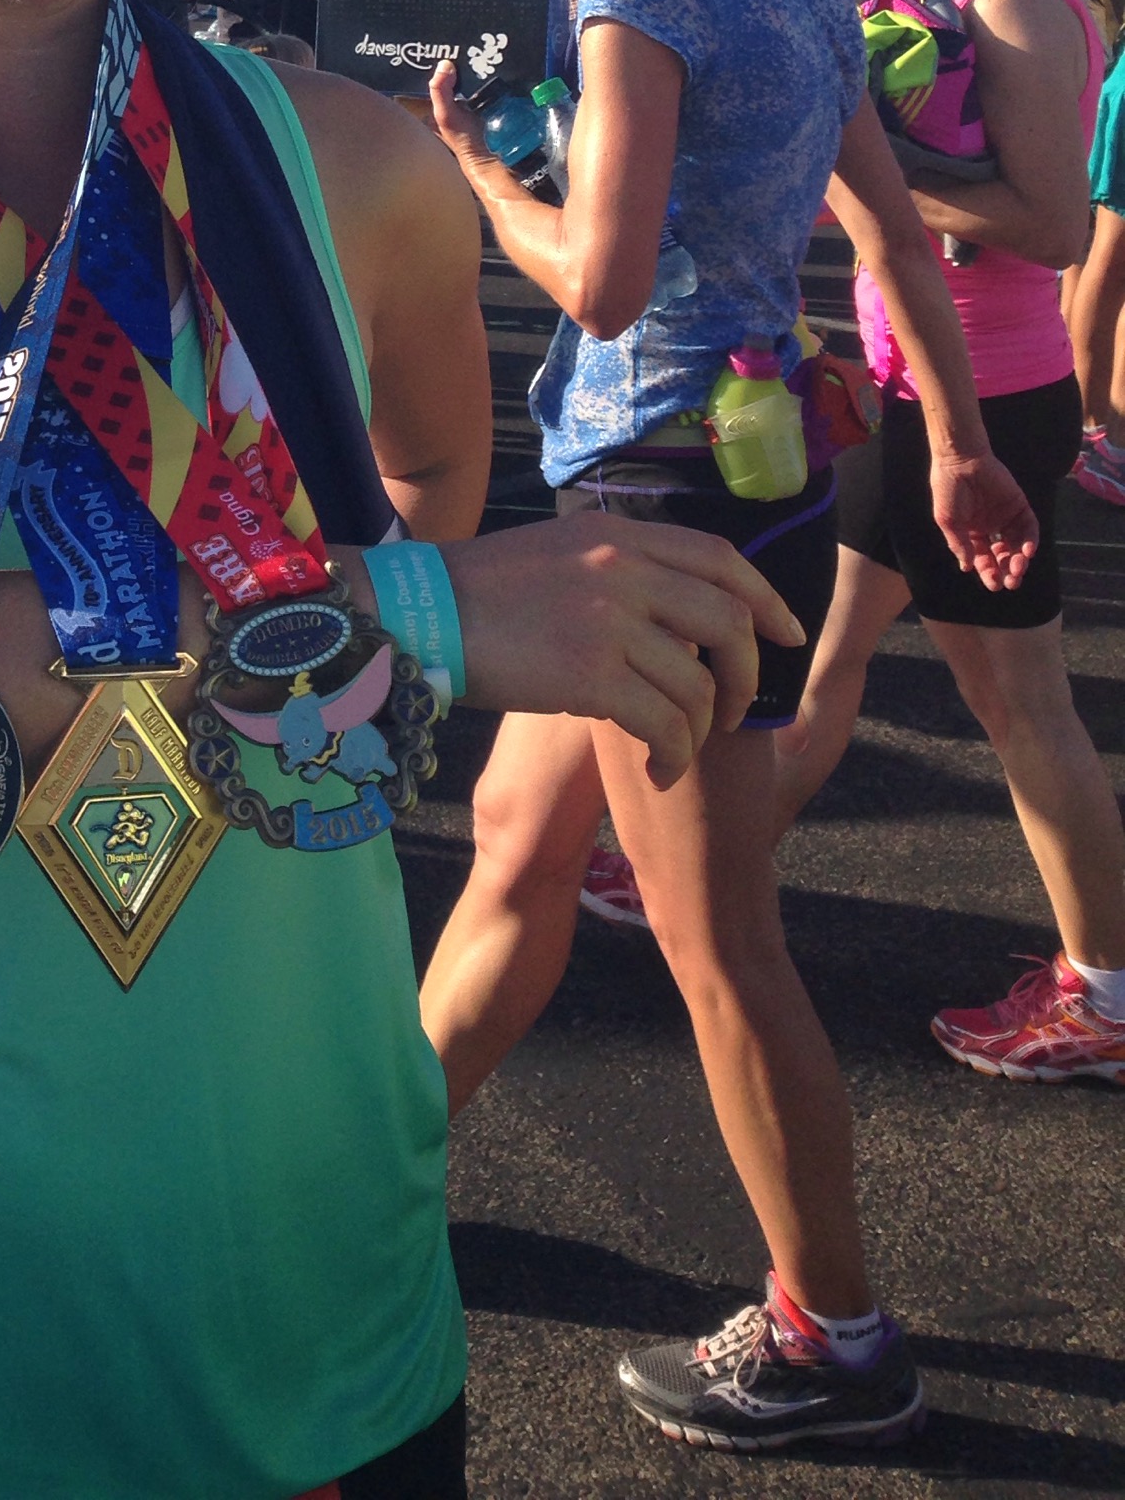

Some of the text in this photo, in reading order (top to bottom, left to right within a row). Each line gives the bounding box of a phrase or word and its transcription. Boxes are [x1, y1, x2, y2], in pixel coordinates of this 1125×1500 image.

[355, 33, 460, 70] runDisney
[219, 490, 260, 536] Cigna
[79, 490, 162, 650] MARATHON
[393, 570, 411, 605] Coast
[253, 613, 322, 643] DUMBO
[425, 611, 440, 648] Race
[141, 708, 166, 740] HALF
[110, 737, 143, 781] D
[307, 804, 381, 845] 2015
[105, 851, 153, 866] Disneyland
